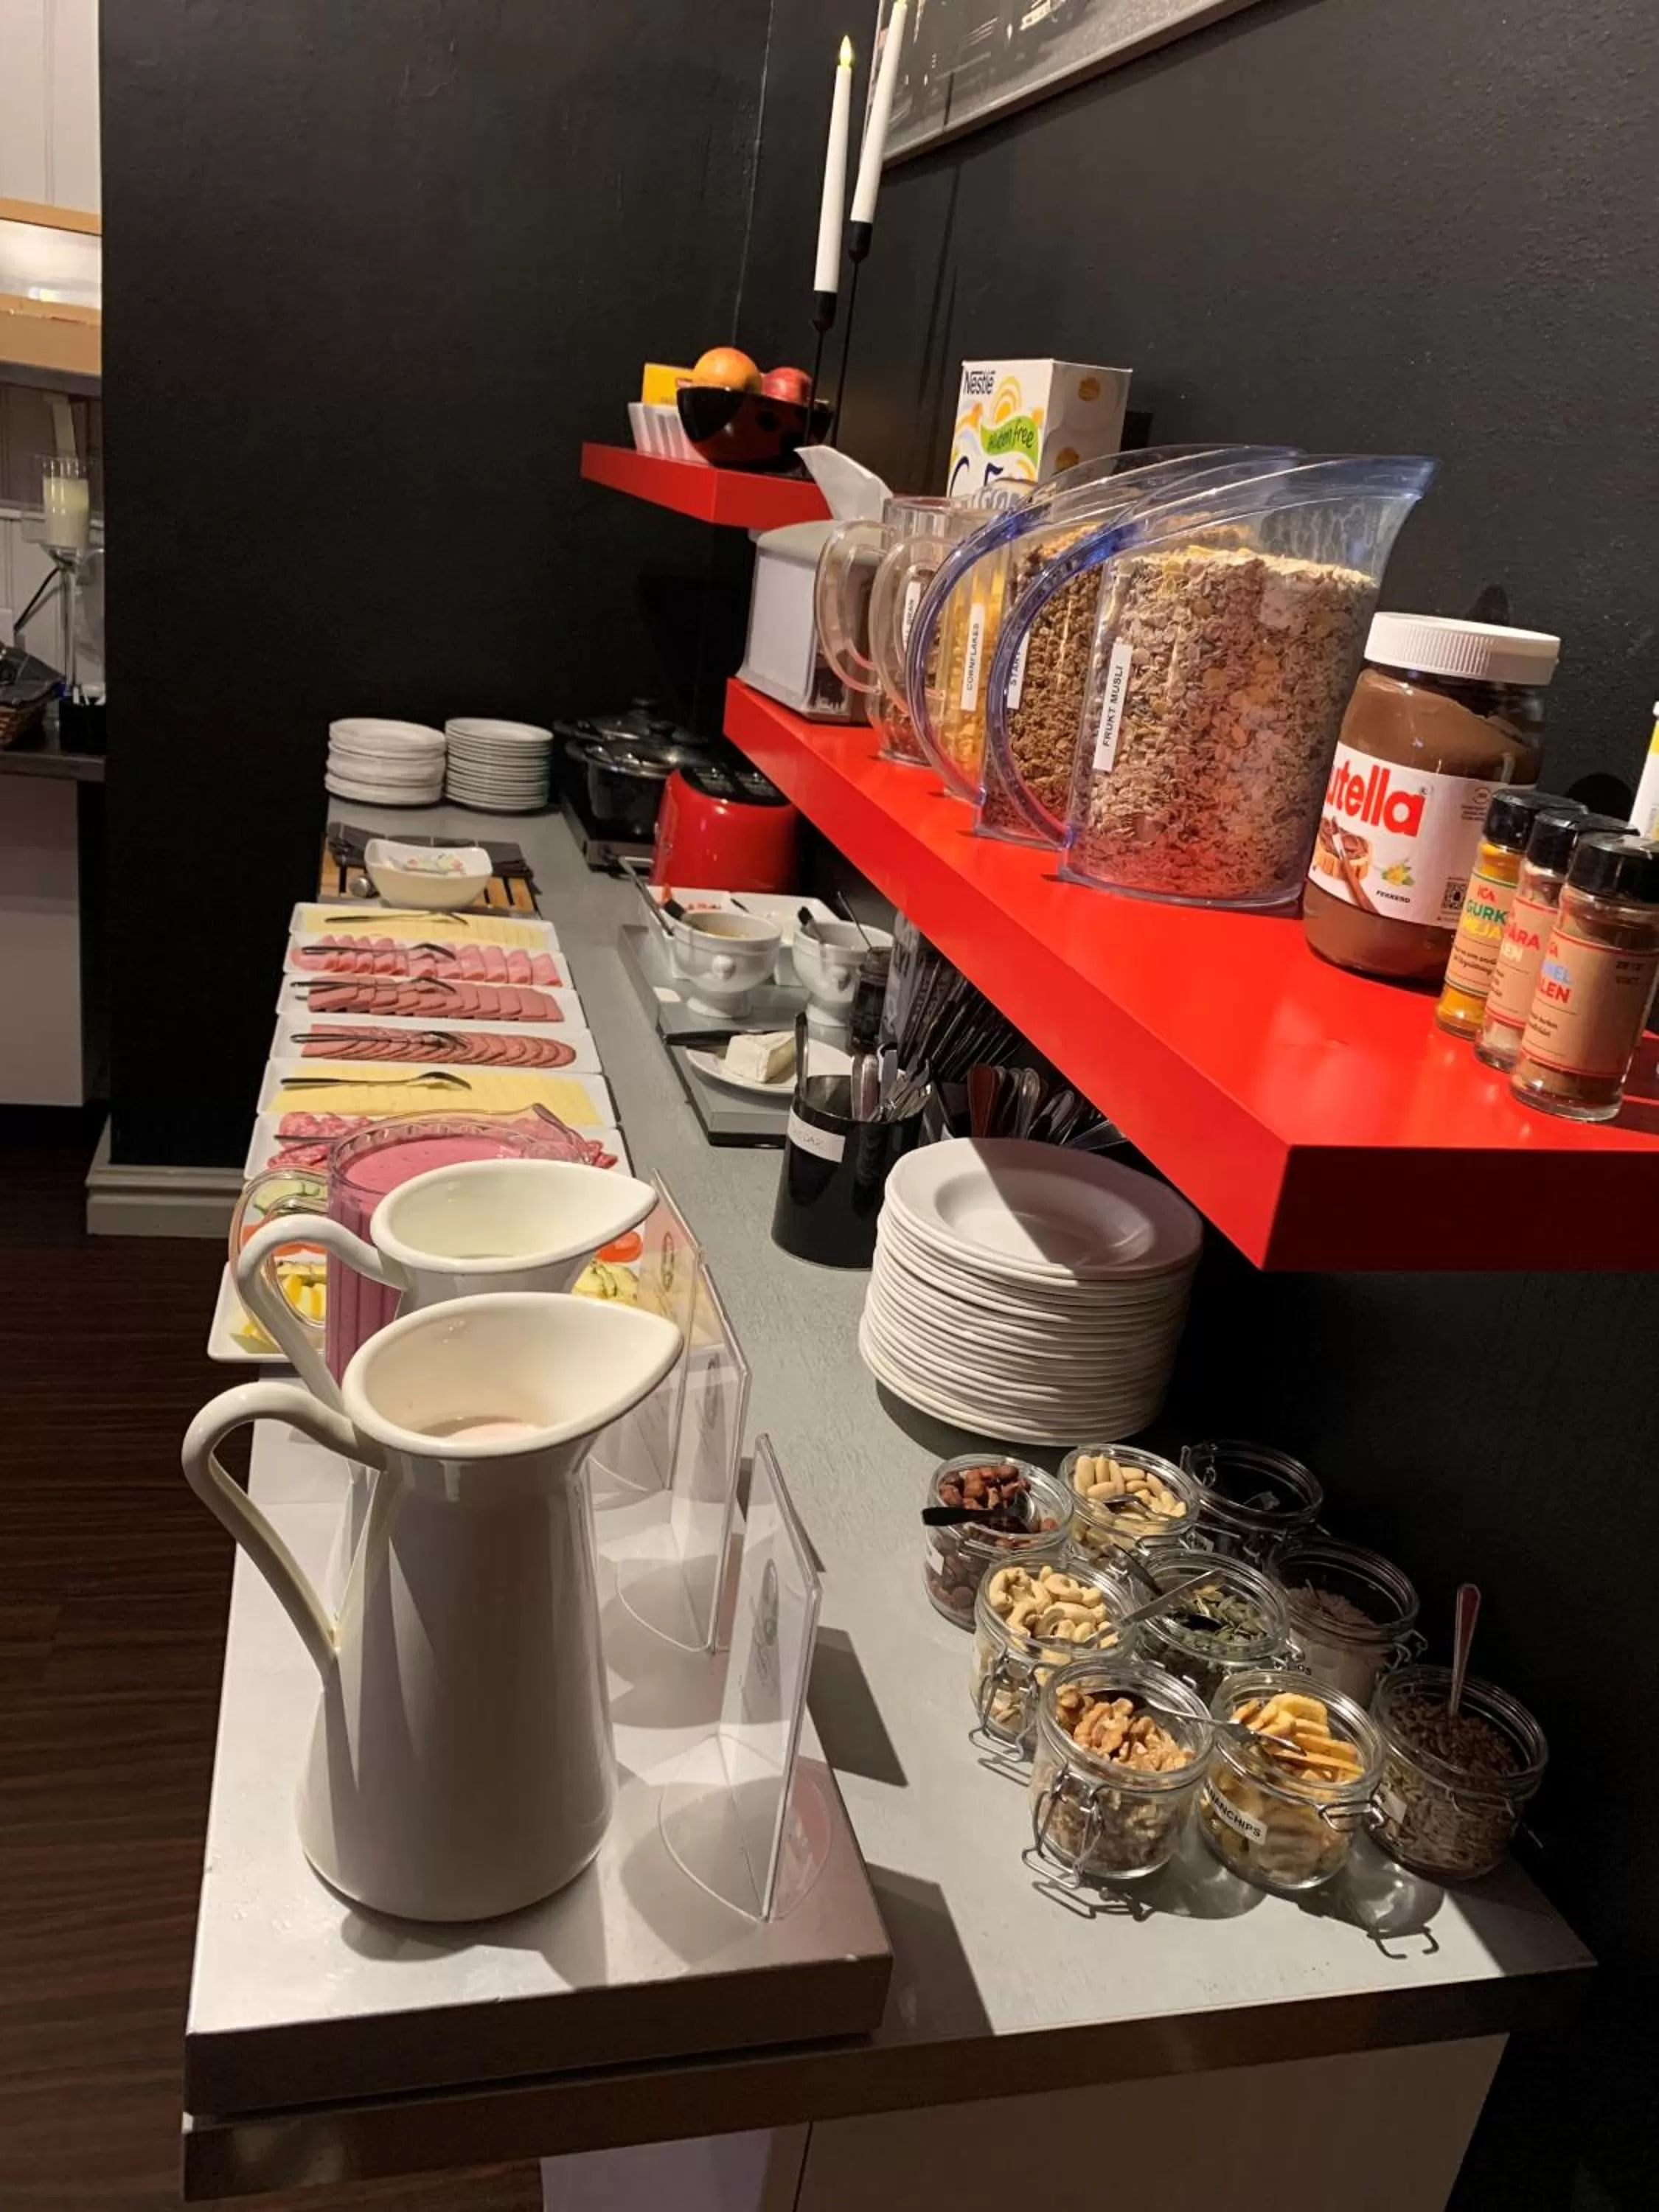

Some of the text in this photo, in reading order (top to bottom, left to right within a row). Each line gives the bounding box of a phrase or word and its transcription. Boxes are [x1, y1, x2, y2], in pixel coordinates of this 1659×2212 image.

[967, 622, 980, 692] CORNFLAKES
[1102, 664, 1124, 748] FRUKT MUSLI
[1326, 759, 1426, 838] utella
[1539, 976, 1571, 1004] LEN
